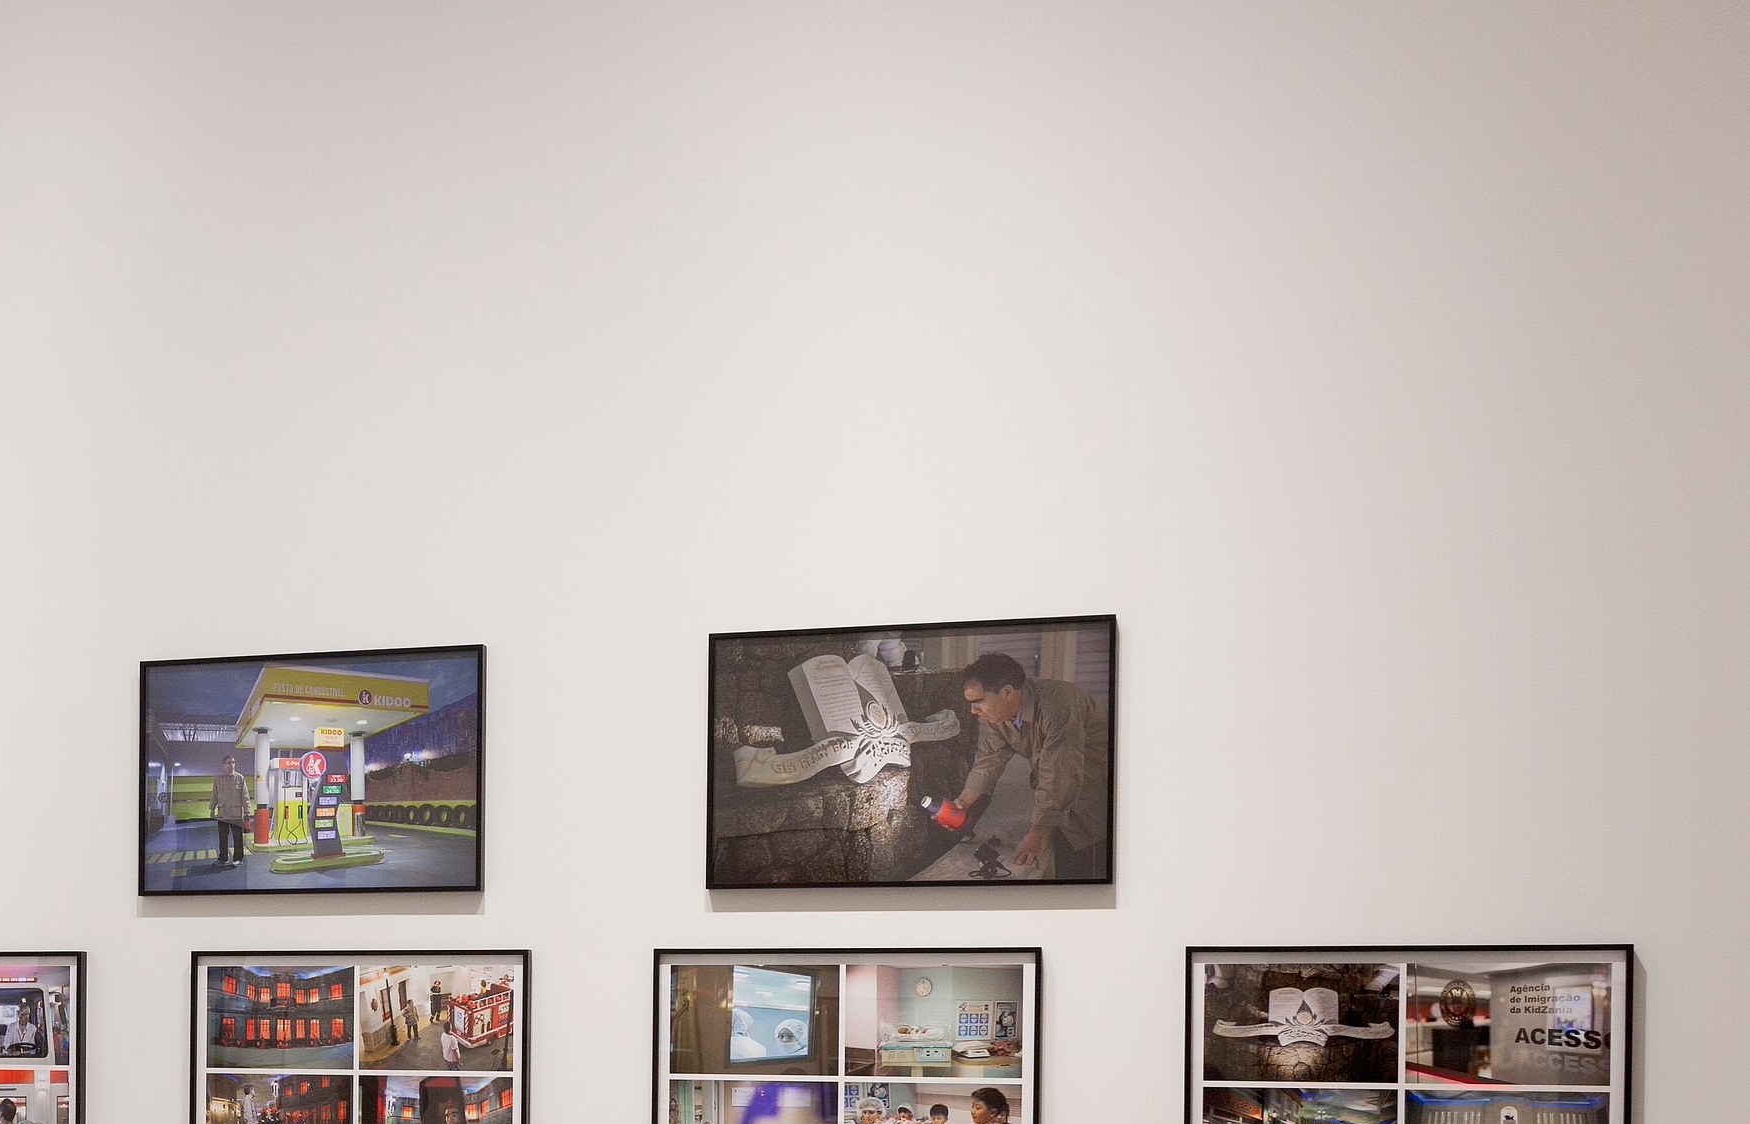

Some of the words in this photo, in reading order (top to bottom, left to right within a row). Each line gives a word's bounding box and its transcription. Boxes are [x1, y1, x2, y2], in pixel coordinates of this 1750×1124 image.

[273, 683, 294, 693] POSTO
[295, 684, 303, 693] DE
[374, 695, 412, 708] KIDCO
[773, 760, 797, 774] GET
[801, 748, 828, 769] READY
[1510, 984, 1550, 994] Agência
[1510, 996, 1521, 1004] de
[1524, 994, 1580, 1005] Imigração
[1524, 1006, 1572, 1014] KidZania
